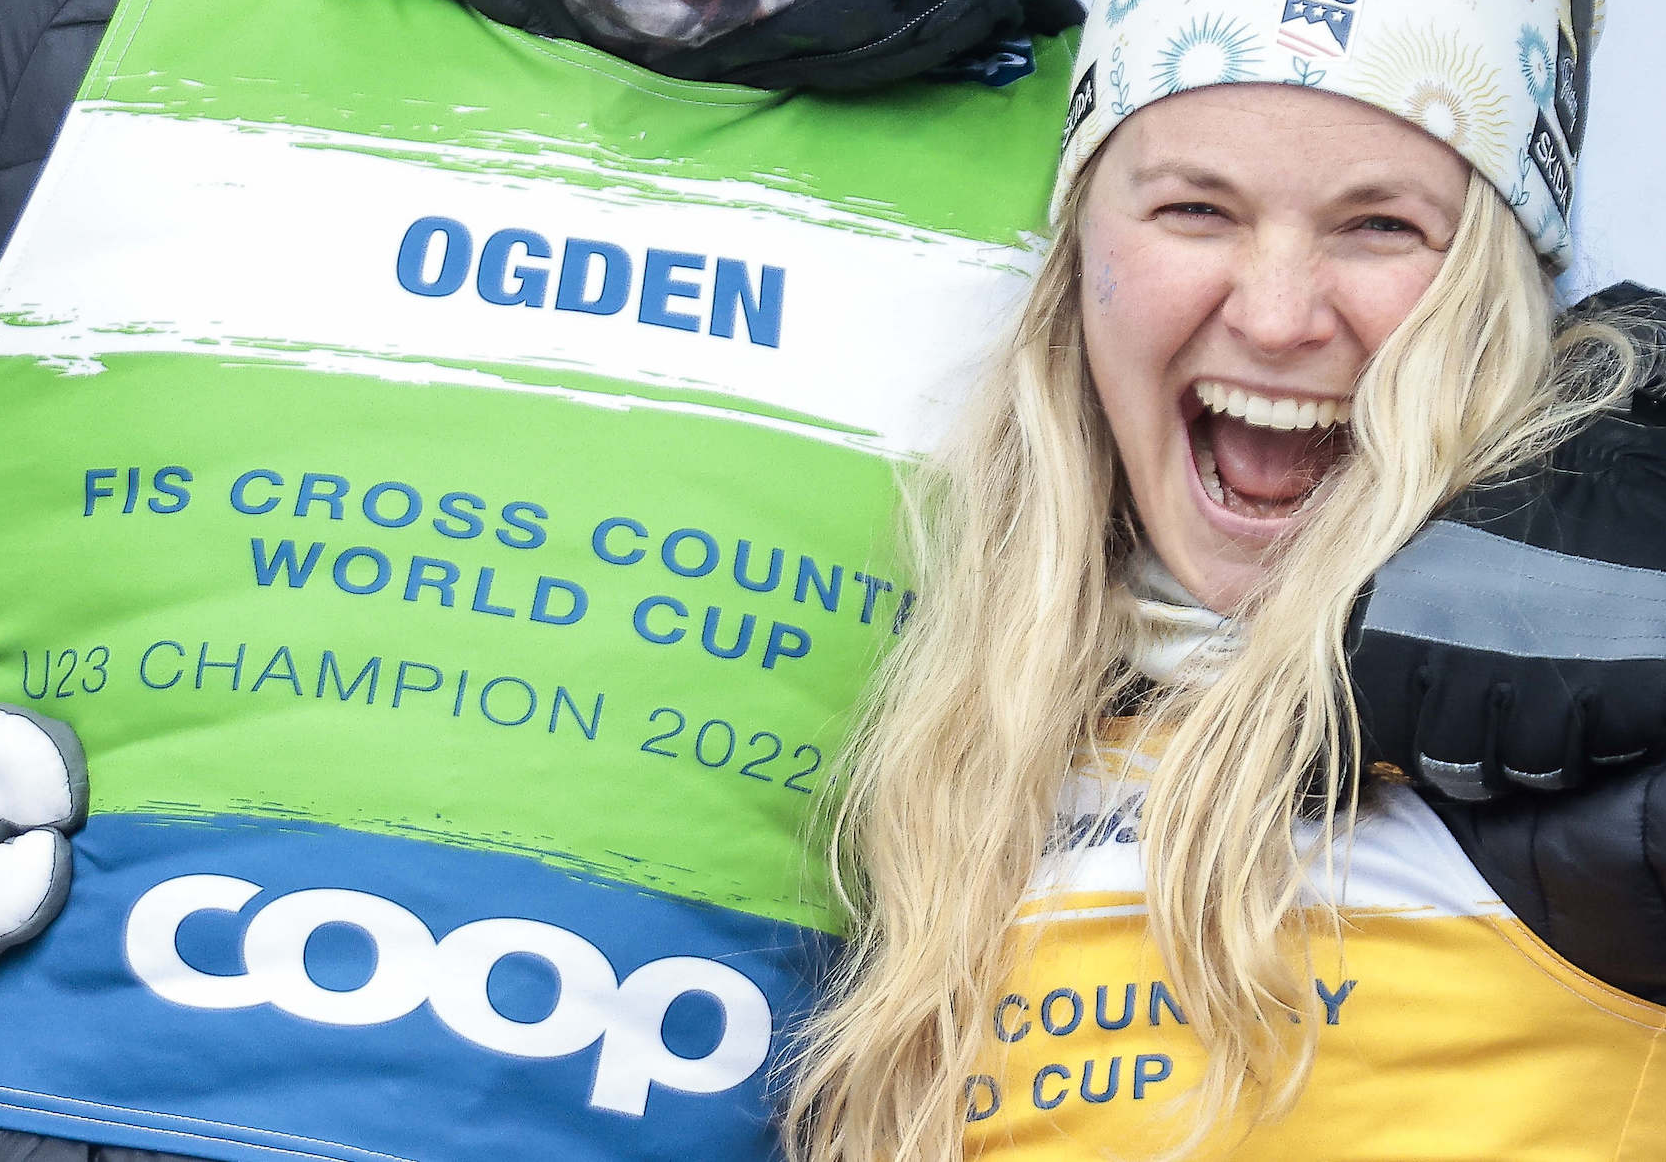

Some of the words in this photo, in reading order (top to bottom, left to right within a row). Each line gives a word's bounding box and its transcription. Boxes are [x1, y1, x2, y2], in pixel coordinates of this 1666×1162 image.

[396, 216, 786, 349] OGDEN
[83, 466, 194, 519] FIS
[230, 468, 550, 551] CROSS
[251, 537, 589, 628] WORLD
[633, 595, 812, 671] CUP
[21, 643, 109, 700] U23
[140, 639, 606, 742] CHAMPION
[640, 707, 836, 795] 2022
[126, 873, 774, 1118] coop
[1033, 1053, 1173, 1110] CUP
